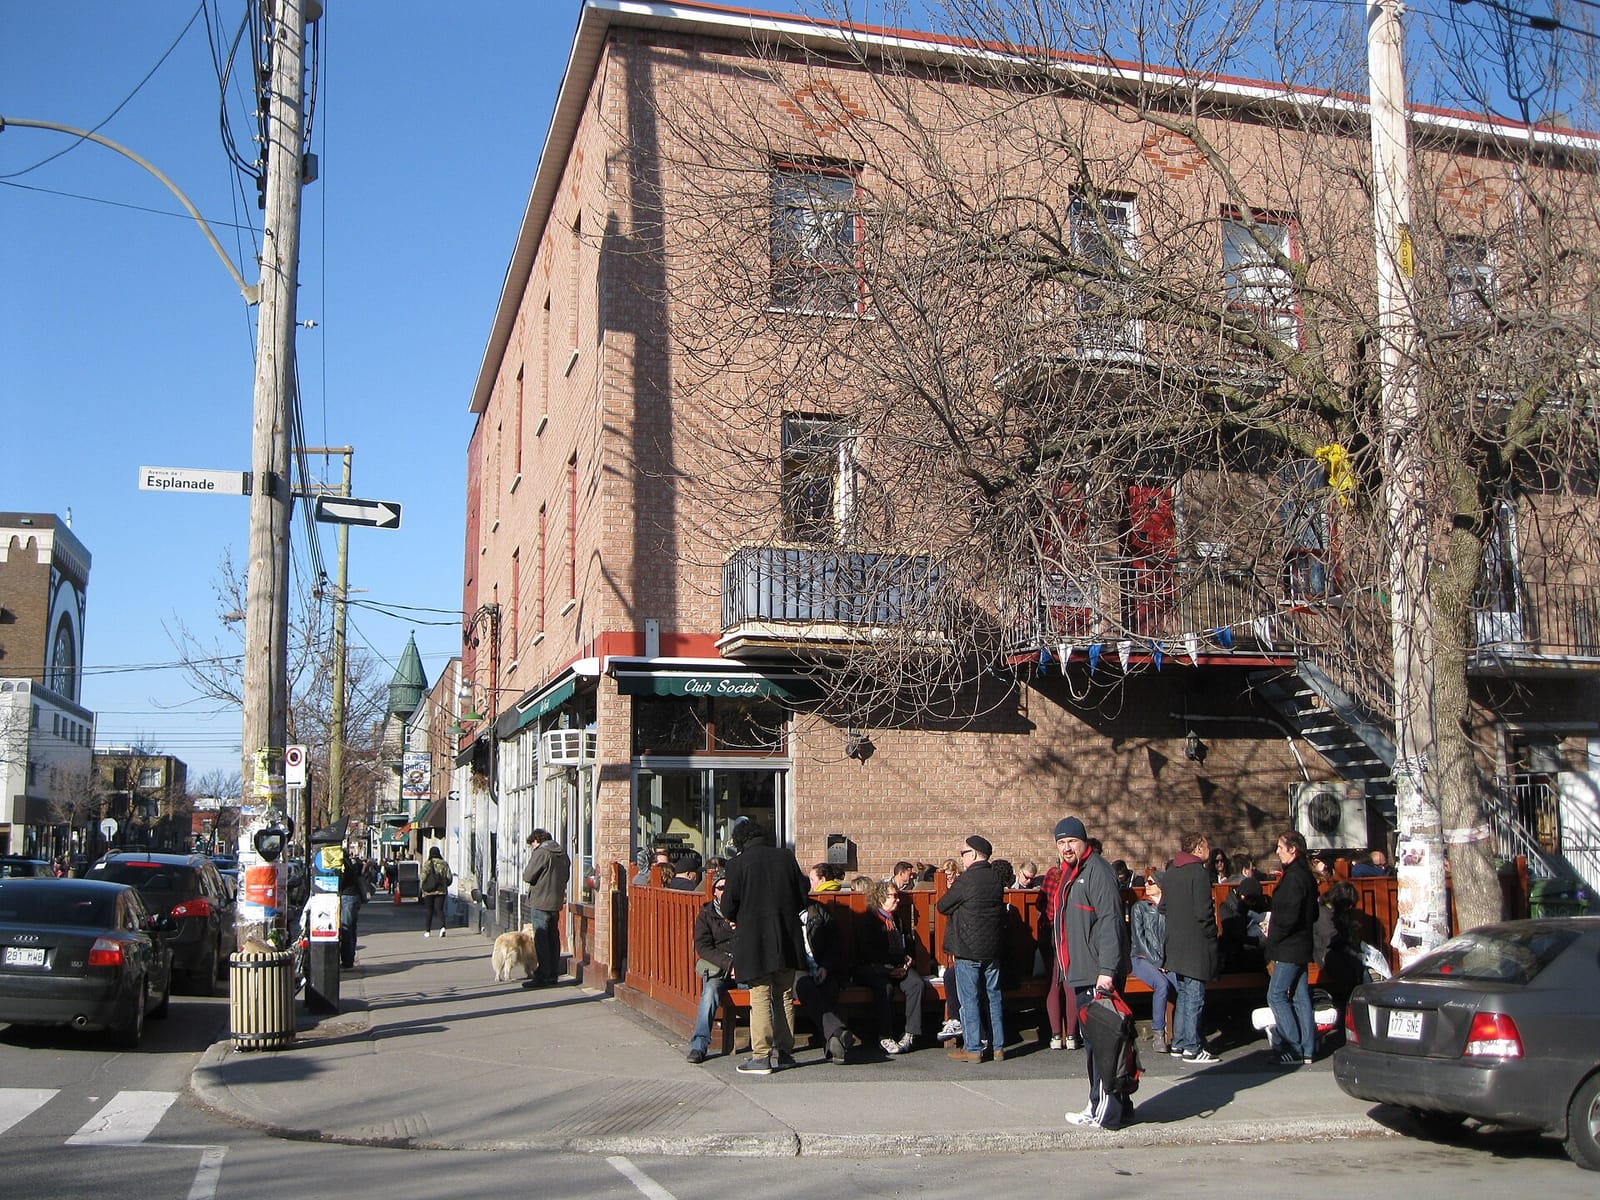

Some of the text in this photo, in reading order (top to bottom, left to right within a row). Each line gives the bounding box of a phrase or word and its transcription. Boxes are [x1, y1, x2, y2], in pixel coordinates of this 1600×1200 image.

[147, 475, 215, 490] Esplanade
[684, 679, 760, 693] Club Social
[7, 950, 22, 961] 291
[1391, 1018, 1420, 1033] 177 SNE
